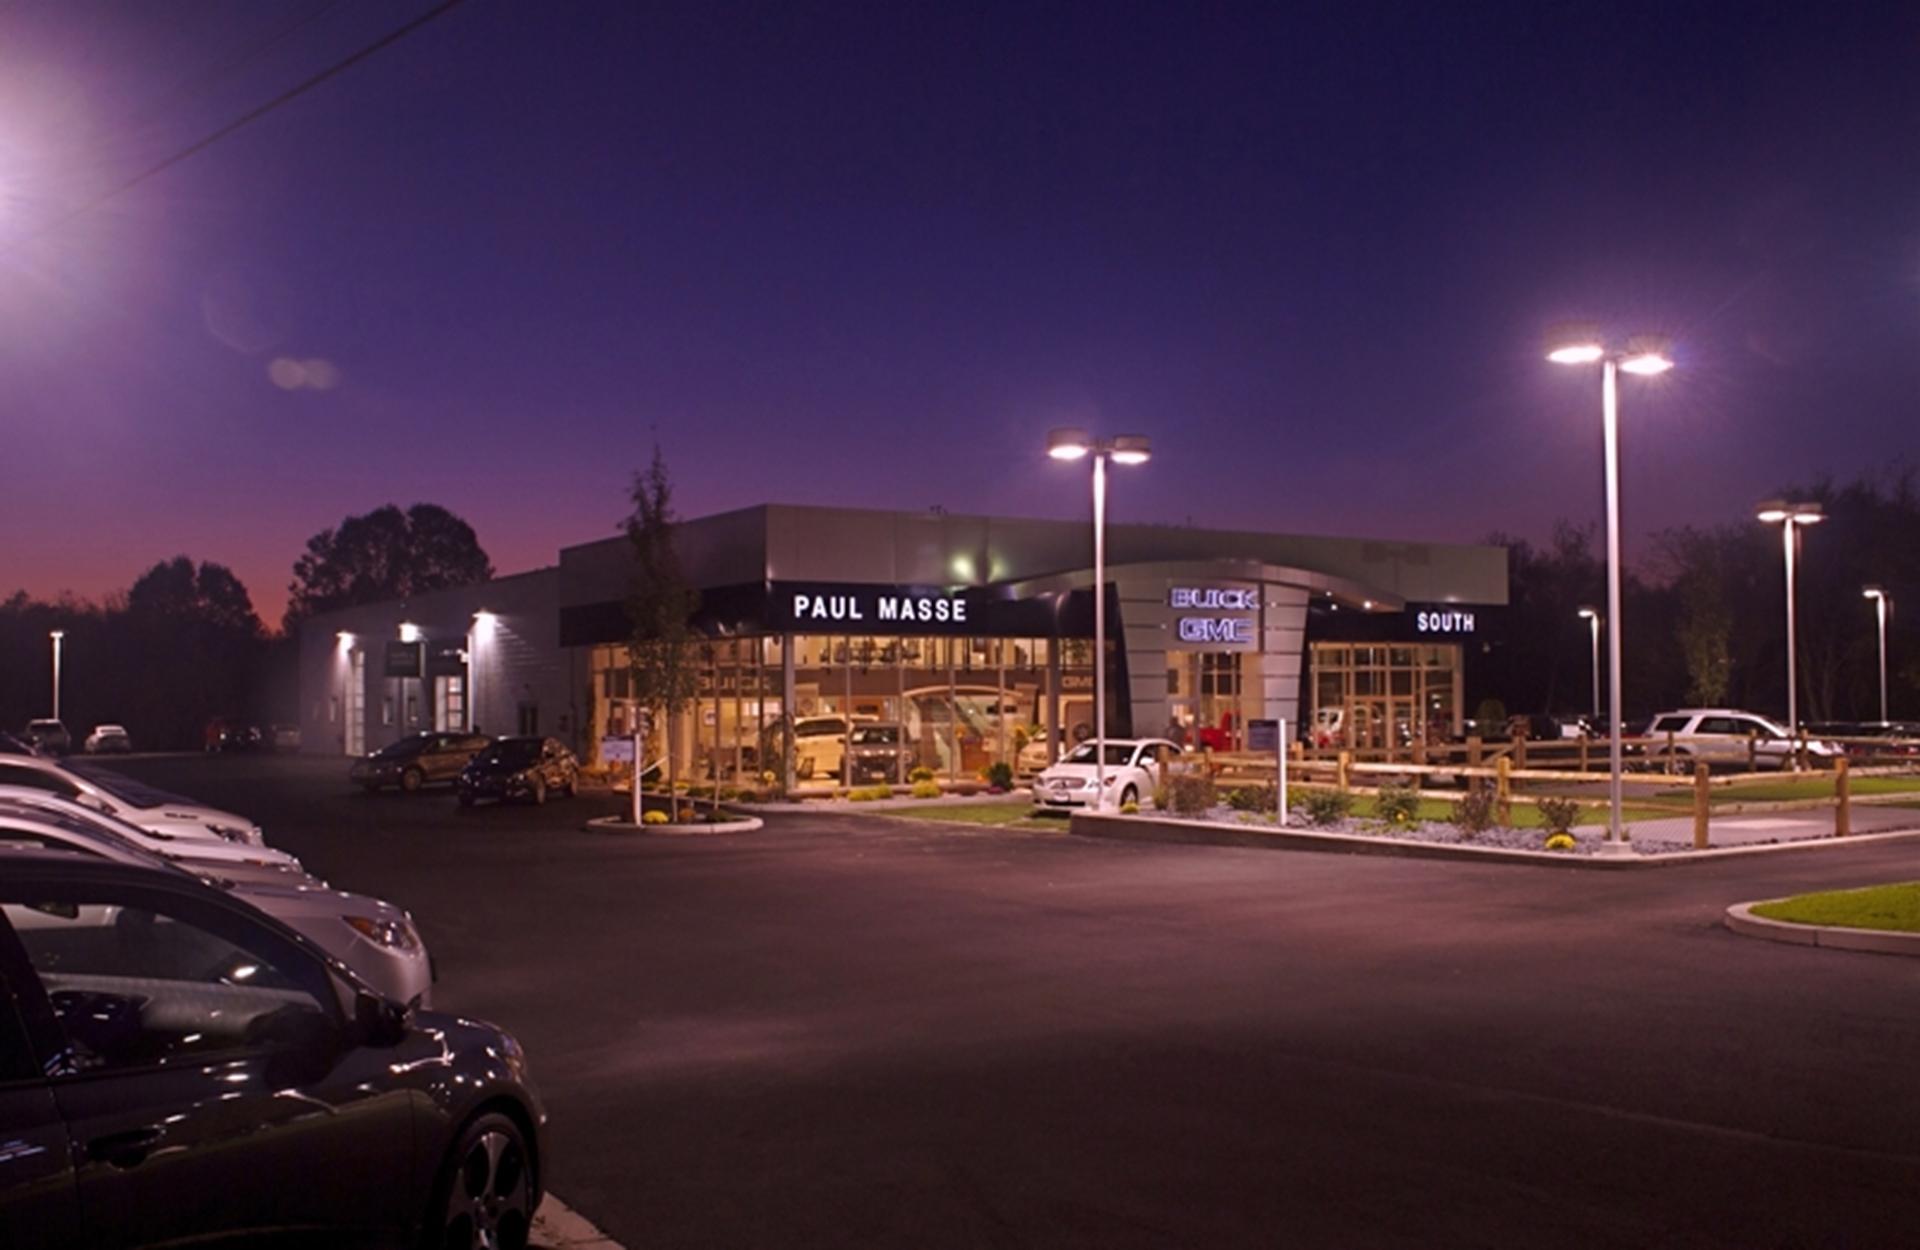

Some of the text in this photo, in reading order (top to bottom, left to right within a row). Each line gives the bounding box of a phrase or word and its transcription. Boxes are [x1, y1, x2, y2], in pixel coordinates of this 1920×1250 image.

[794, 595, 966, 621] PAUL MASSE
[1171, 588, 1259, 609] BUICK
[1180, 618, 1253, 642] GMC
[1417, 612, 1474, 632] SOUTH
